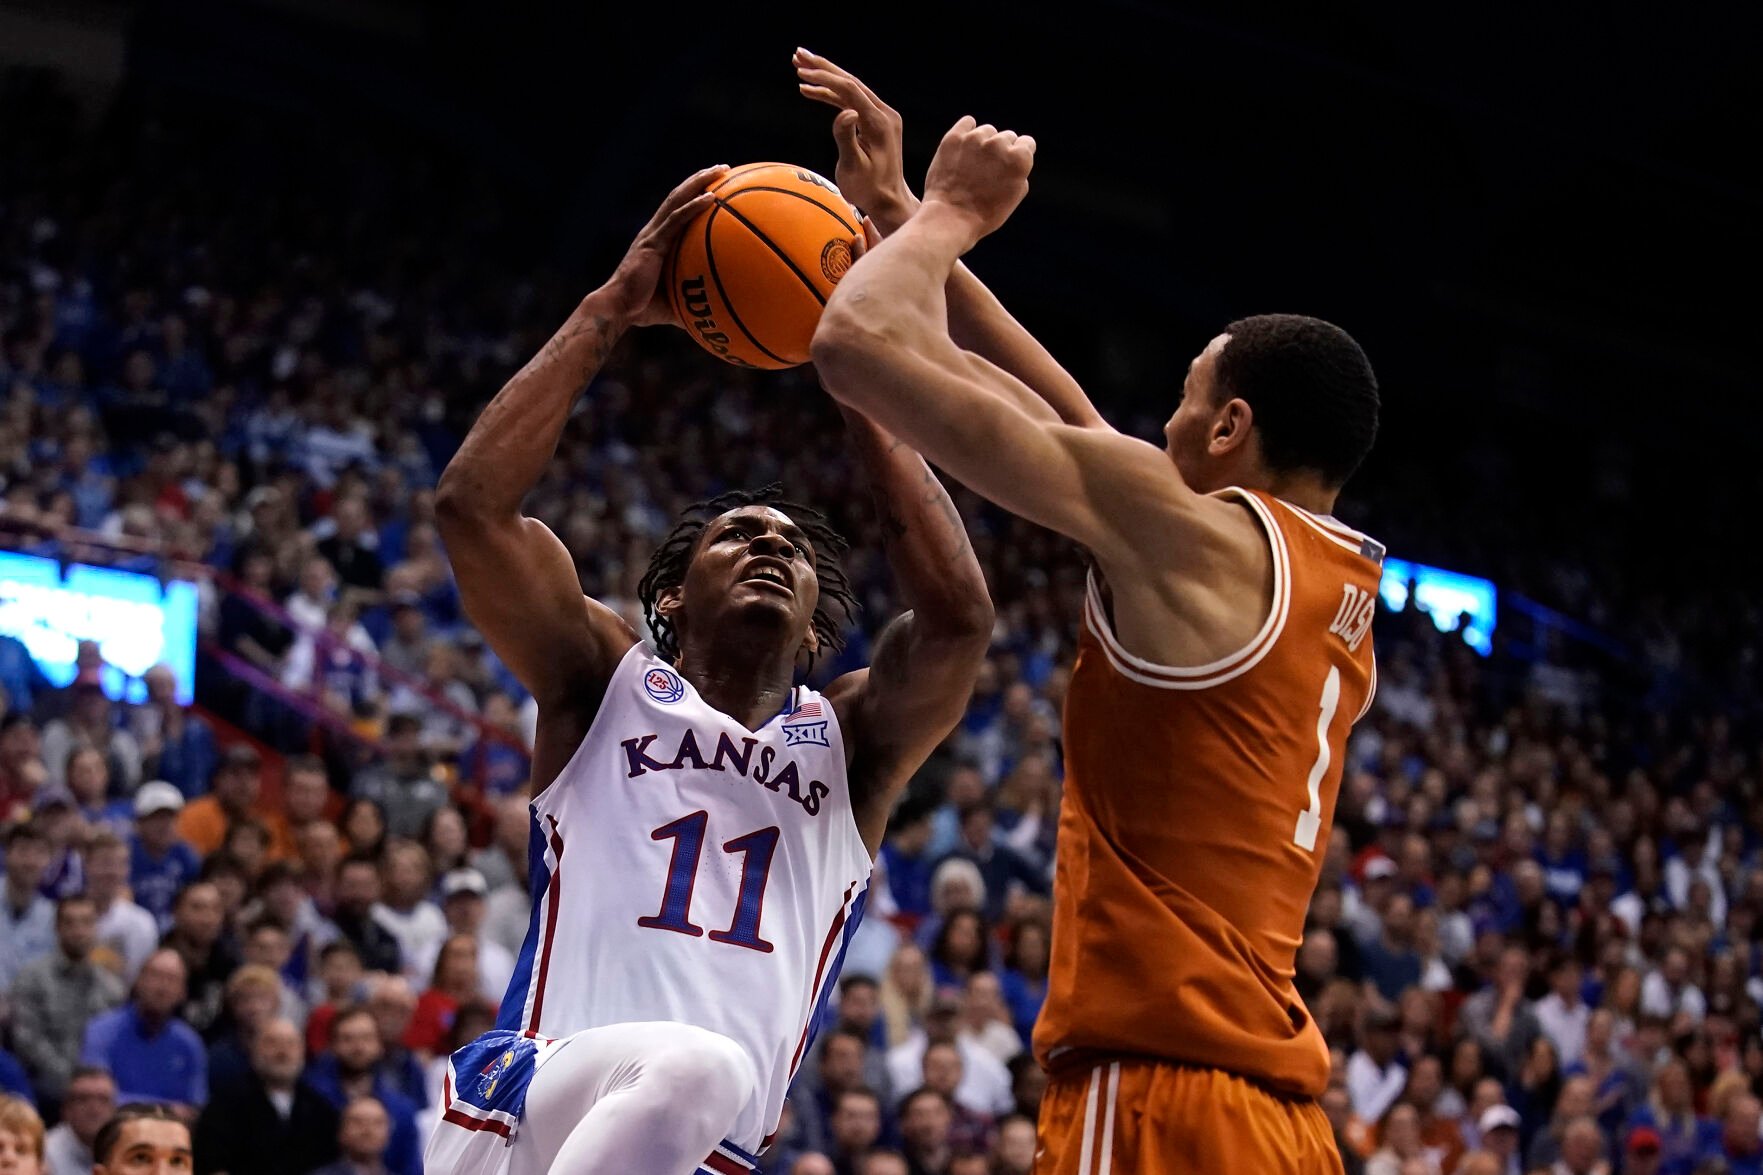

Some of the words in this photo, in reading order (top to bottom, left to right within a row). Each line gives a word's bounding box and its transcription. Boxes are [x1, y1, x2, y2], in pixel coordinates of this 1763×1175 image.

[648, 673, 668, 690] 125
[621, 728, 830, 816] KANSAS
[1294, 664, 1340, 852] 1
[637, 809, 780, 953] 11
